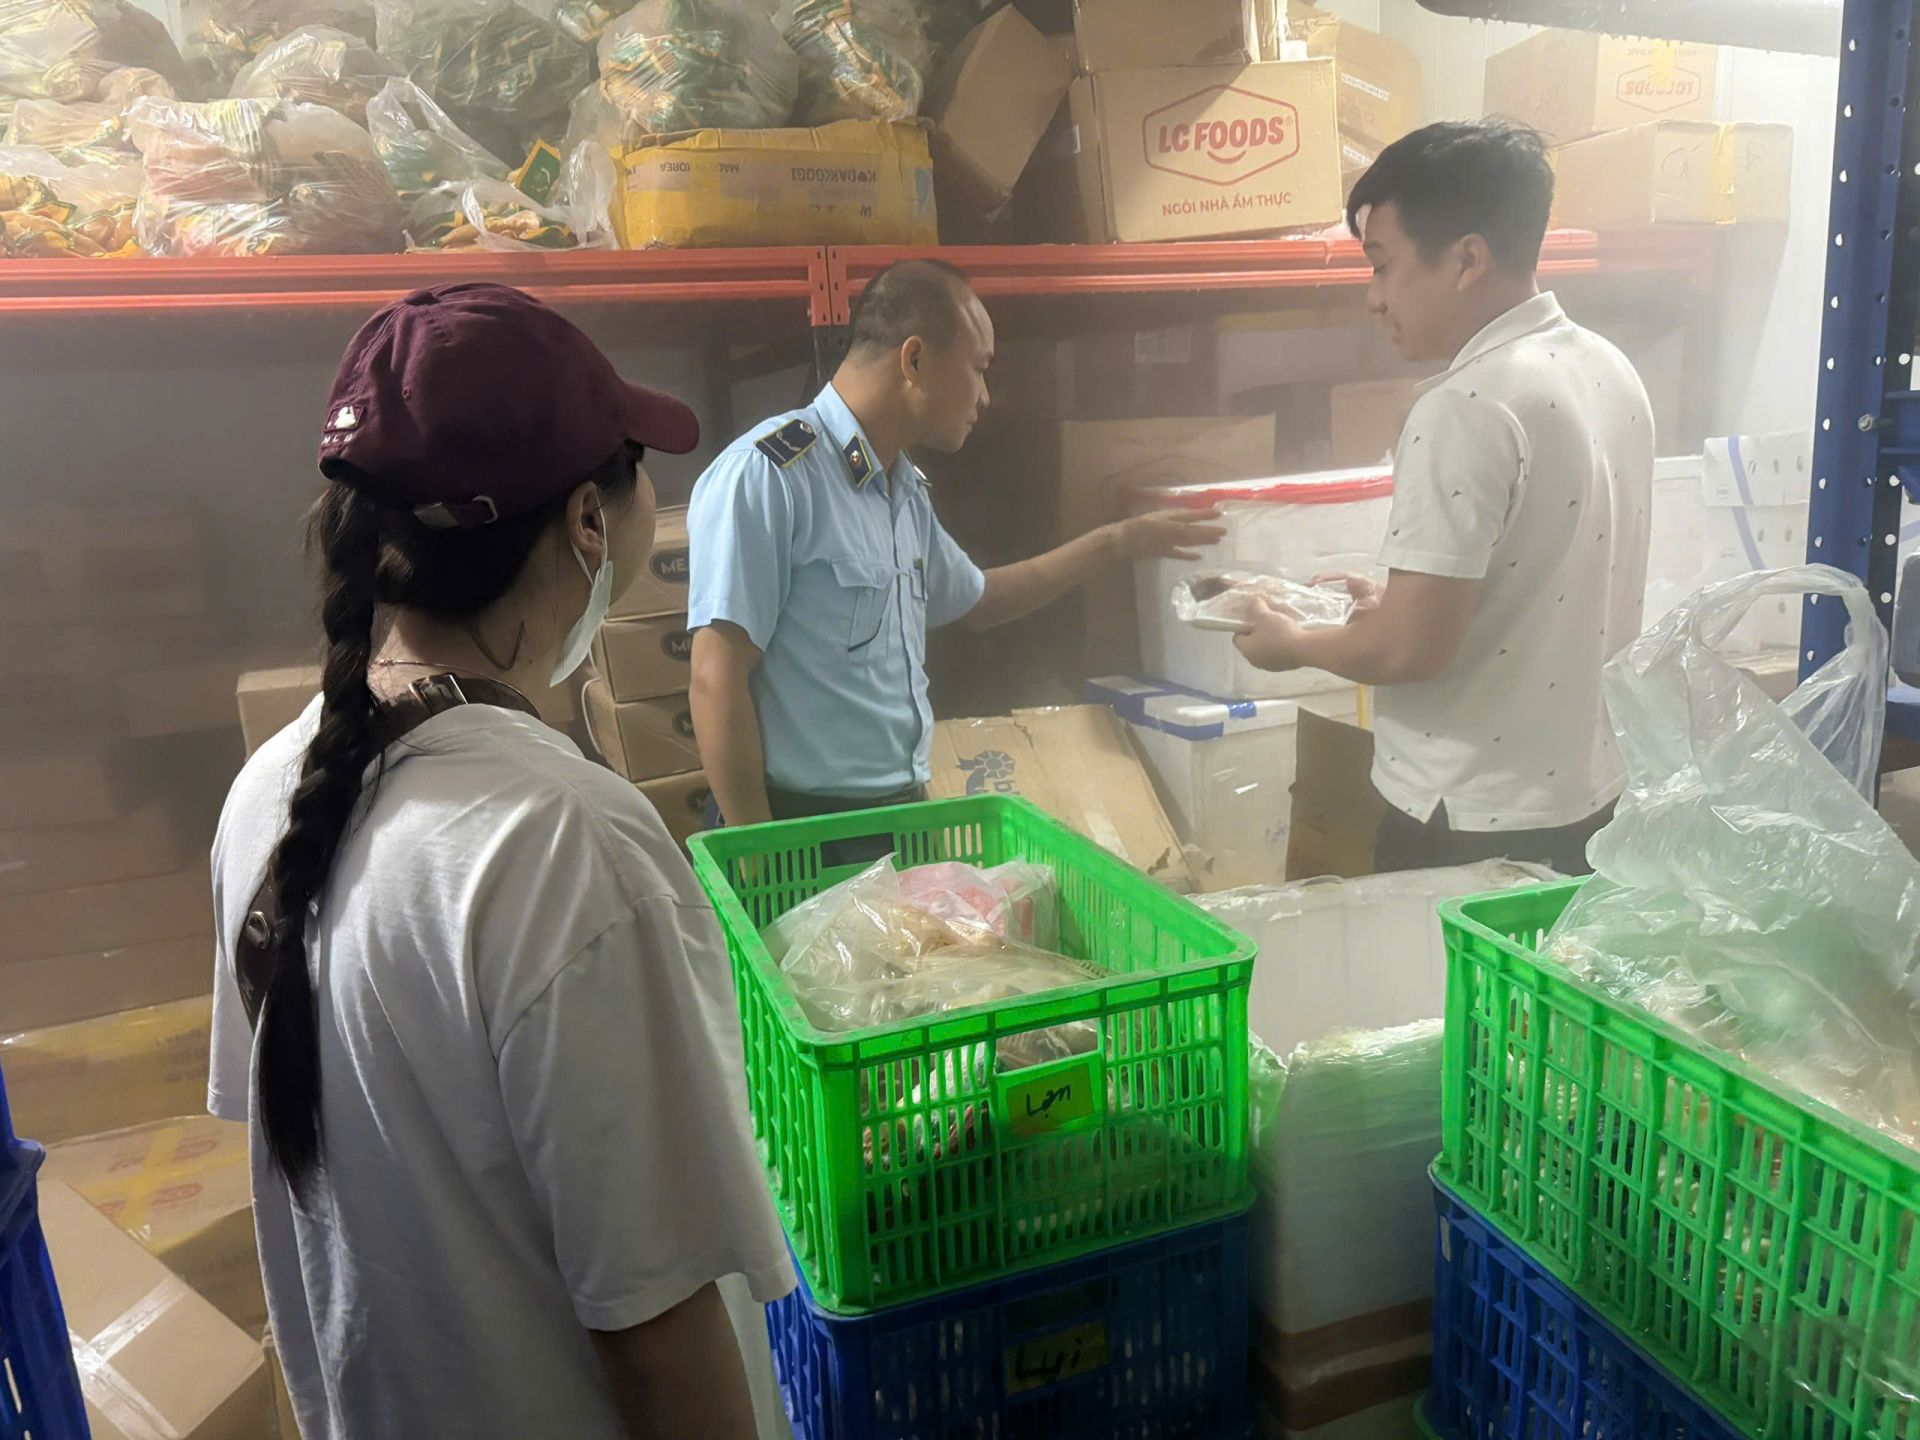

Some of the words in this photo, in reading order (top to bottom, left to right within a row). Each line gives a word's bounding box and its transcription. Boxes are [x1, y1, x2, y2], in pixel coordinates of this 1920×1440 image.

[1158, 123, 1190, 153] LC
[1194, 116, 1284, 150] FOODS
[1162, 199, 1196, 216] NGÔI
[1200, 195, 1229, 212] NHÀ
[1256, 191, 1292, 208] THỰC
[660, 558, 688, 574] ME
